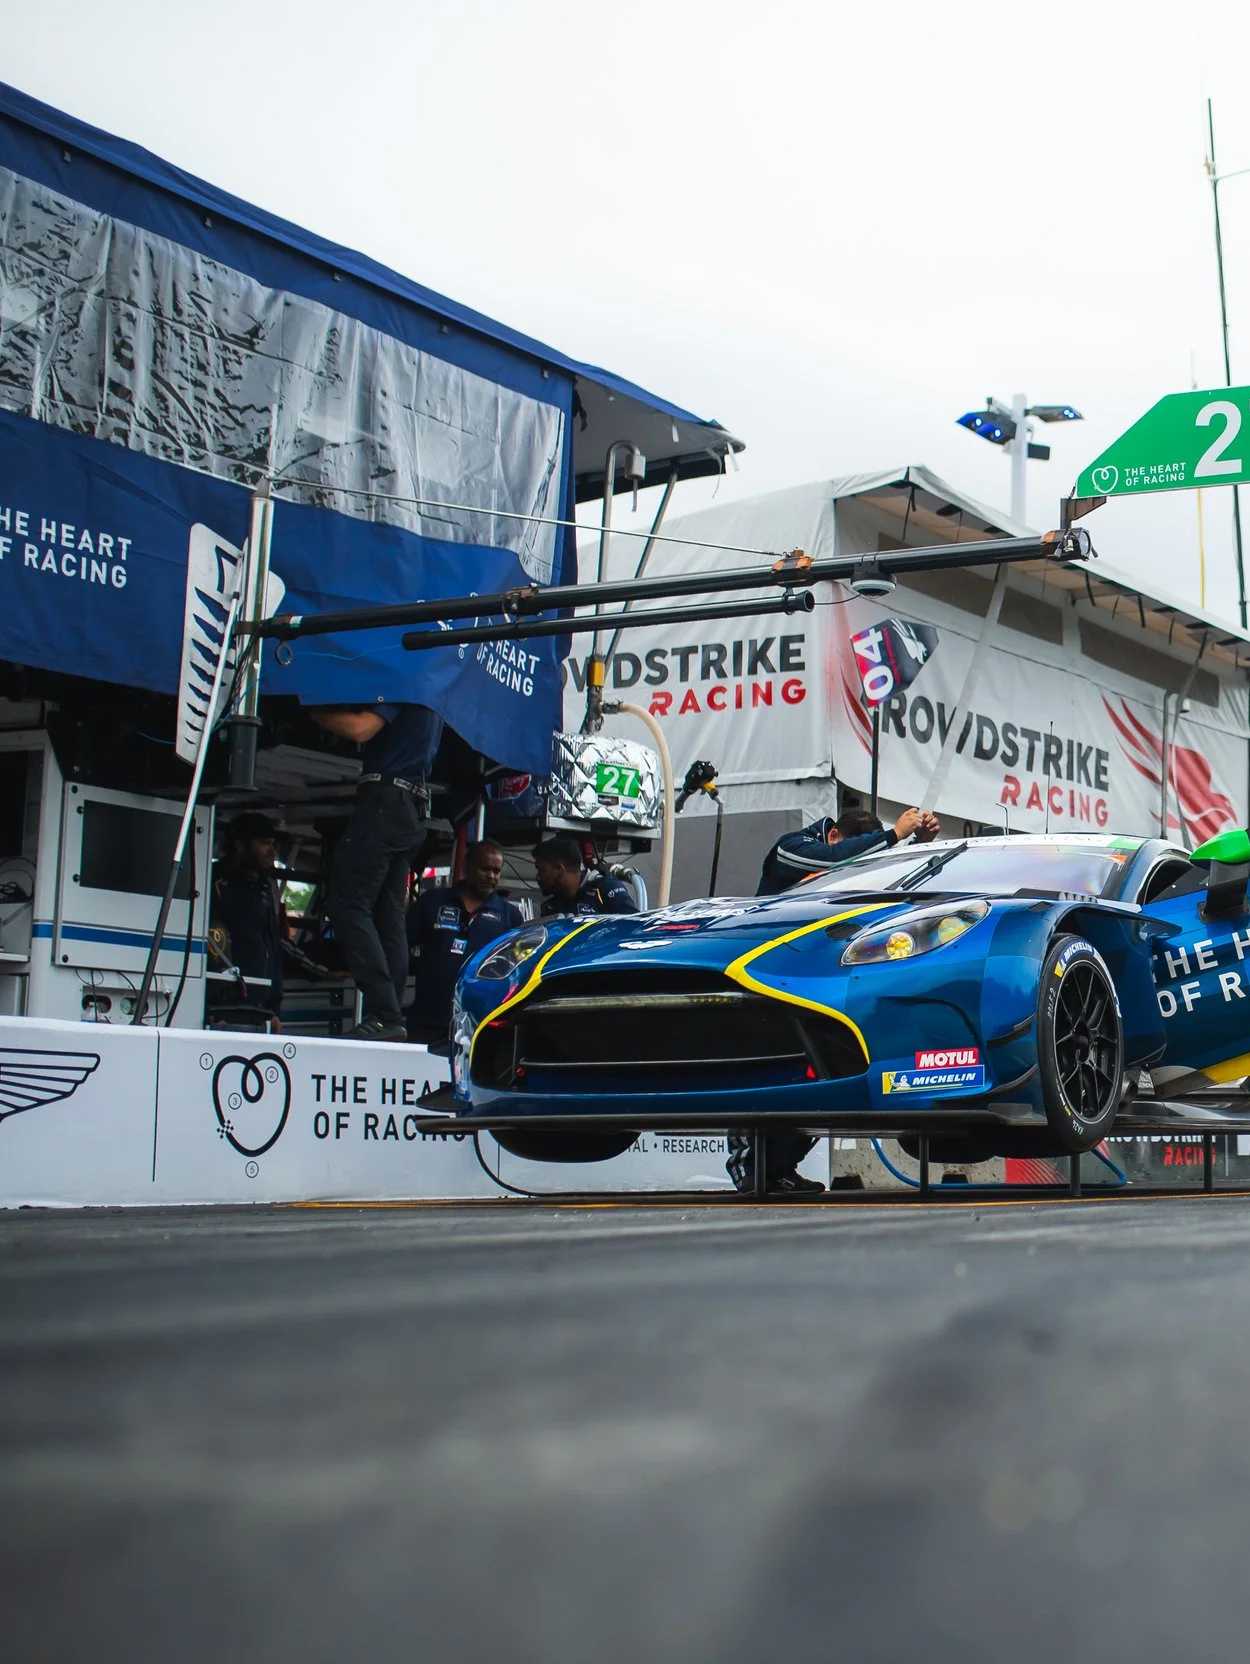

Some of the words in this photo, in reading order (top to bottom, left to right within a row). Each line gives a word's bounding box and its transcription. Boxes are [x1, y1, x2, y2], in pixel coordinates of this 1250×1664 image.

[1124, 468, 1146, 477] THE
[1149, 462, 1186, 475] HEART
[1125, 477, 1139, 487] OF
[1143, 472, 1185, 485] RACING
[0, 505, 30, 537] HE
[40, 517, 132, 561] HEART
[24, 542, 127, 589] RACING
[486, 653, 534, 697] RACING
[853, 628, 894, 701] 04
[649, 678, 806, 718] RACING
[862, 690, 1110, 792] ROWDSTRIKE
[602, 766, 636, 796] 27
[1002, 775, 1109, 828] RACING
[1064, 941, 1093, 962] MICHELIN
[1157, 980, 1202, 1018] OF
[919, 1051, 977, 1068] MOTUL
[311, 1074, 368, 1104] THE
[912, 1072, 976, 1086] MICHELIN
[313, 1111, 351, 1140] OF
[662, 1138, 725, 1154] RESEARCH
